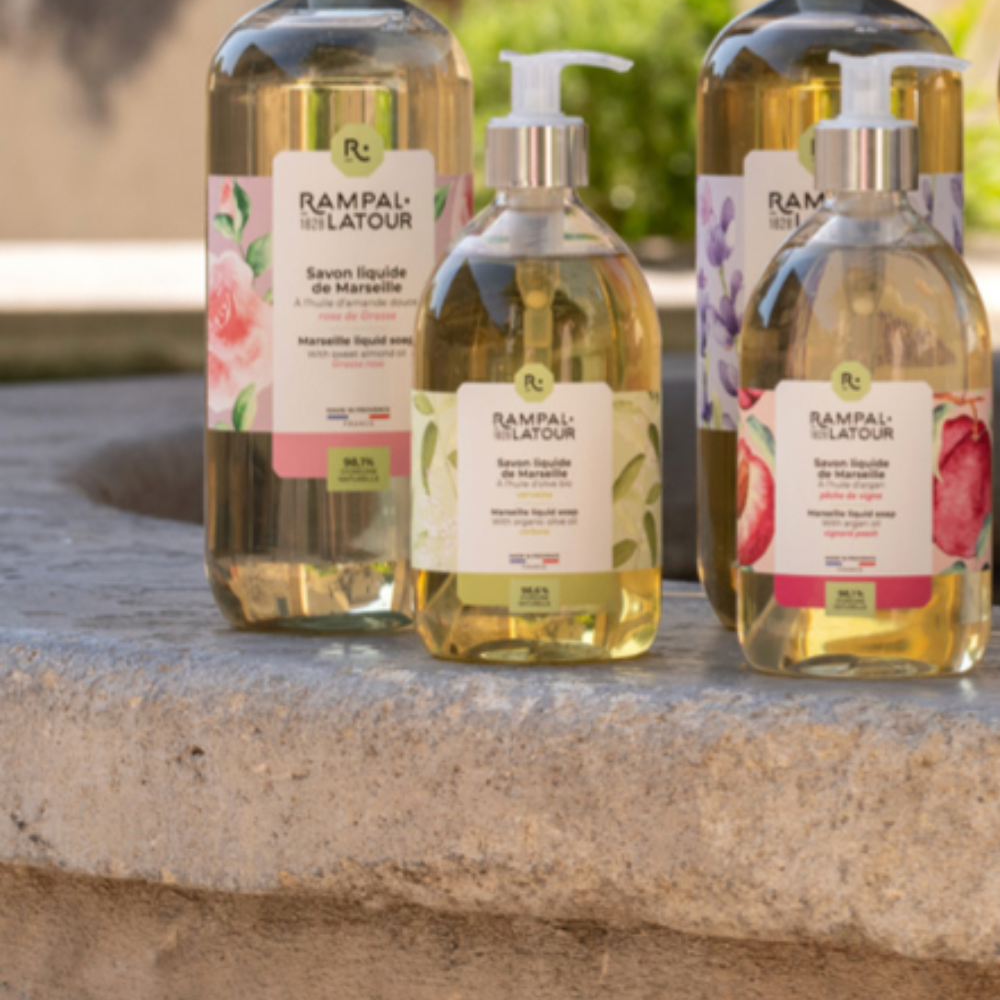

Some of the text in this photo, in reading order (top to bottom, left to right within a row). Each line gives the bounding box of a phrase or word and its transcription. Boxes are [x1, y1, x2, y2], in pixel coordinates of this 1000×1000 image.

[327, 212, 413, 231] LATOUR
[306, 265, 408, 282] Savon liquide
[311, 280, 403, 295] de Marseille
[298, 335, 352, 347] Marseille
[354, 334, 388, 349] liquid
[513, 427, 576, 441] LATOUR
[829, 426, 894, 441] LATOUR
[497, 457, 572, 469] Savon liquide
[814, 457, 891, 470] Savon liquide
[501, 469, 568, 479] de Marseille
[817, 469, 886, 479] de Marseille
